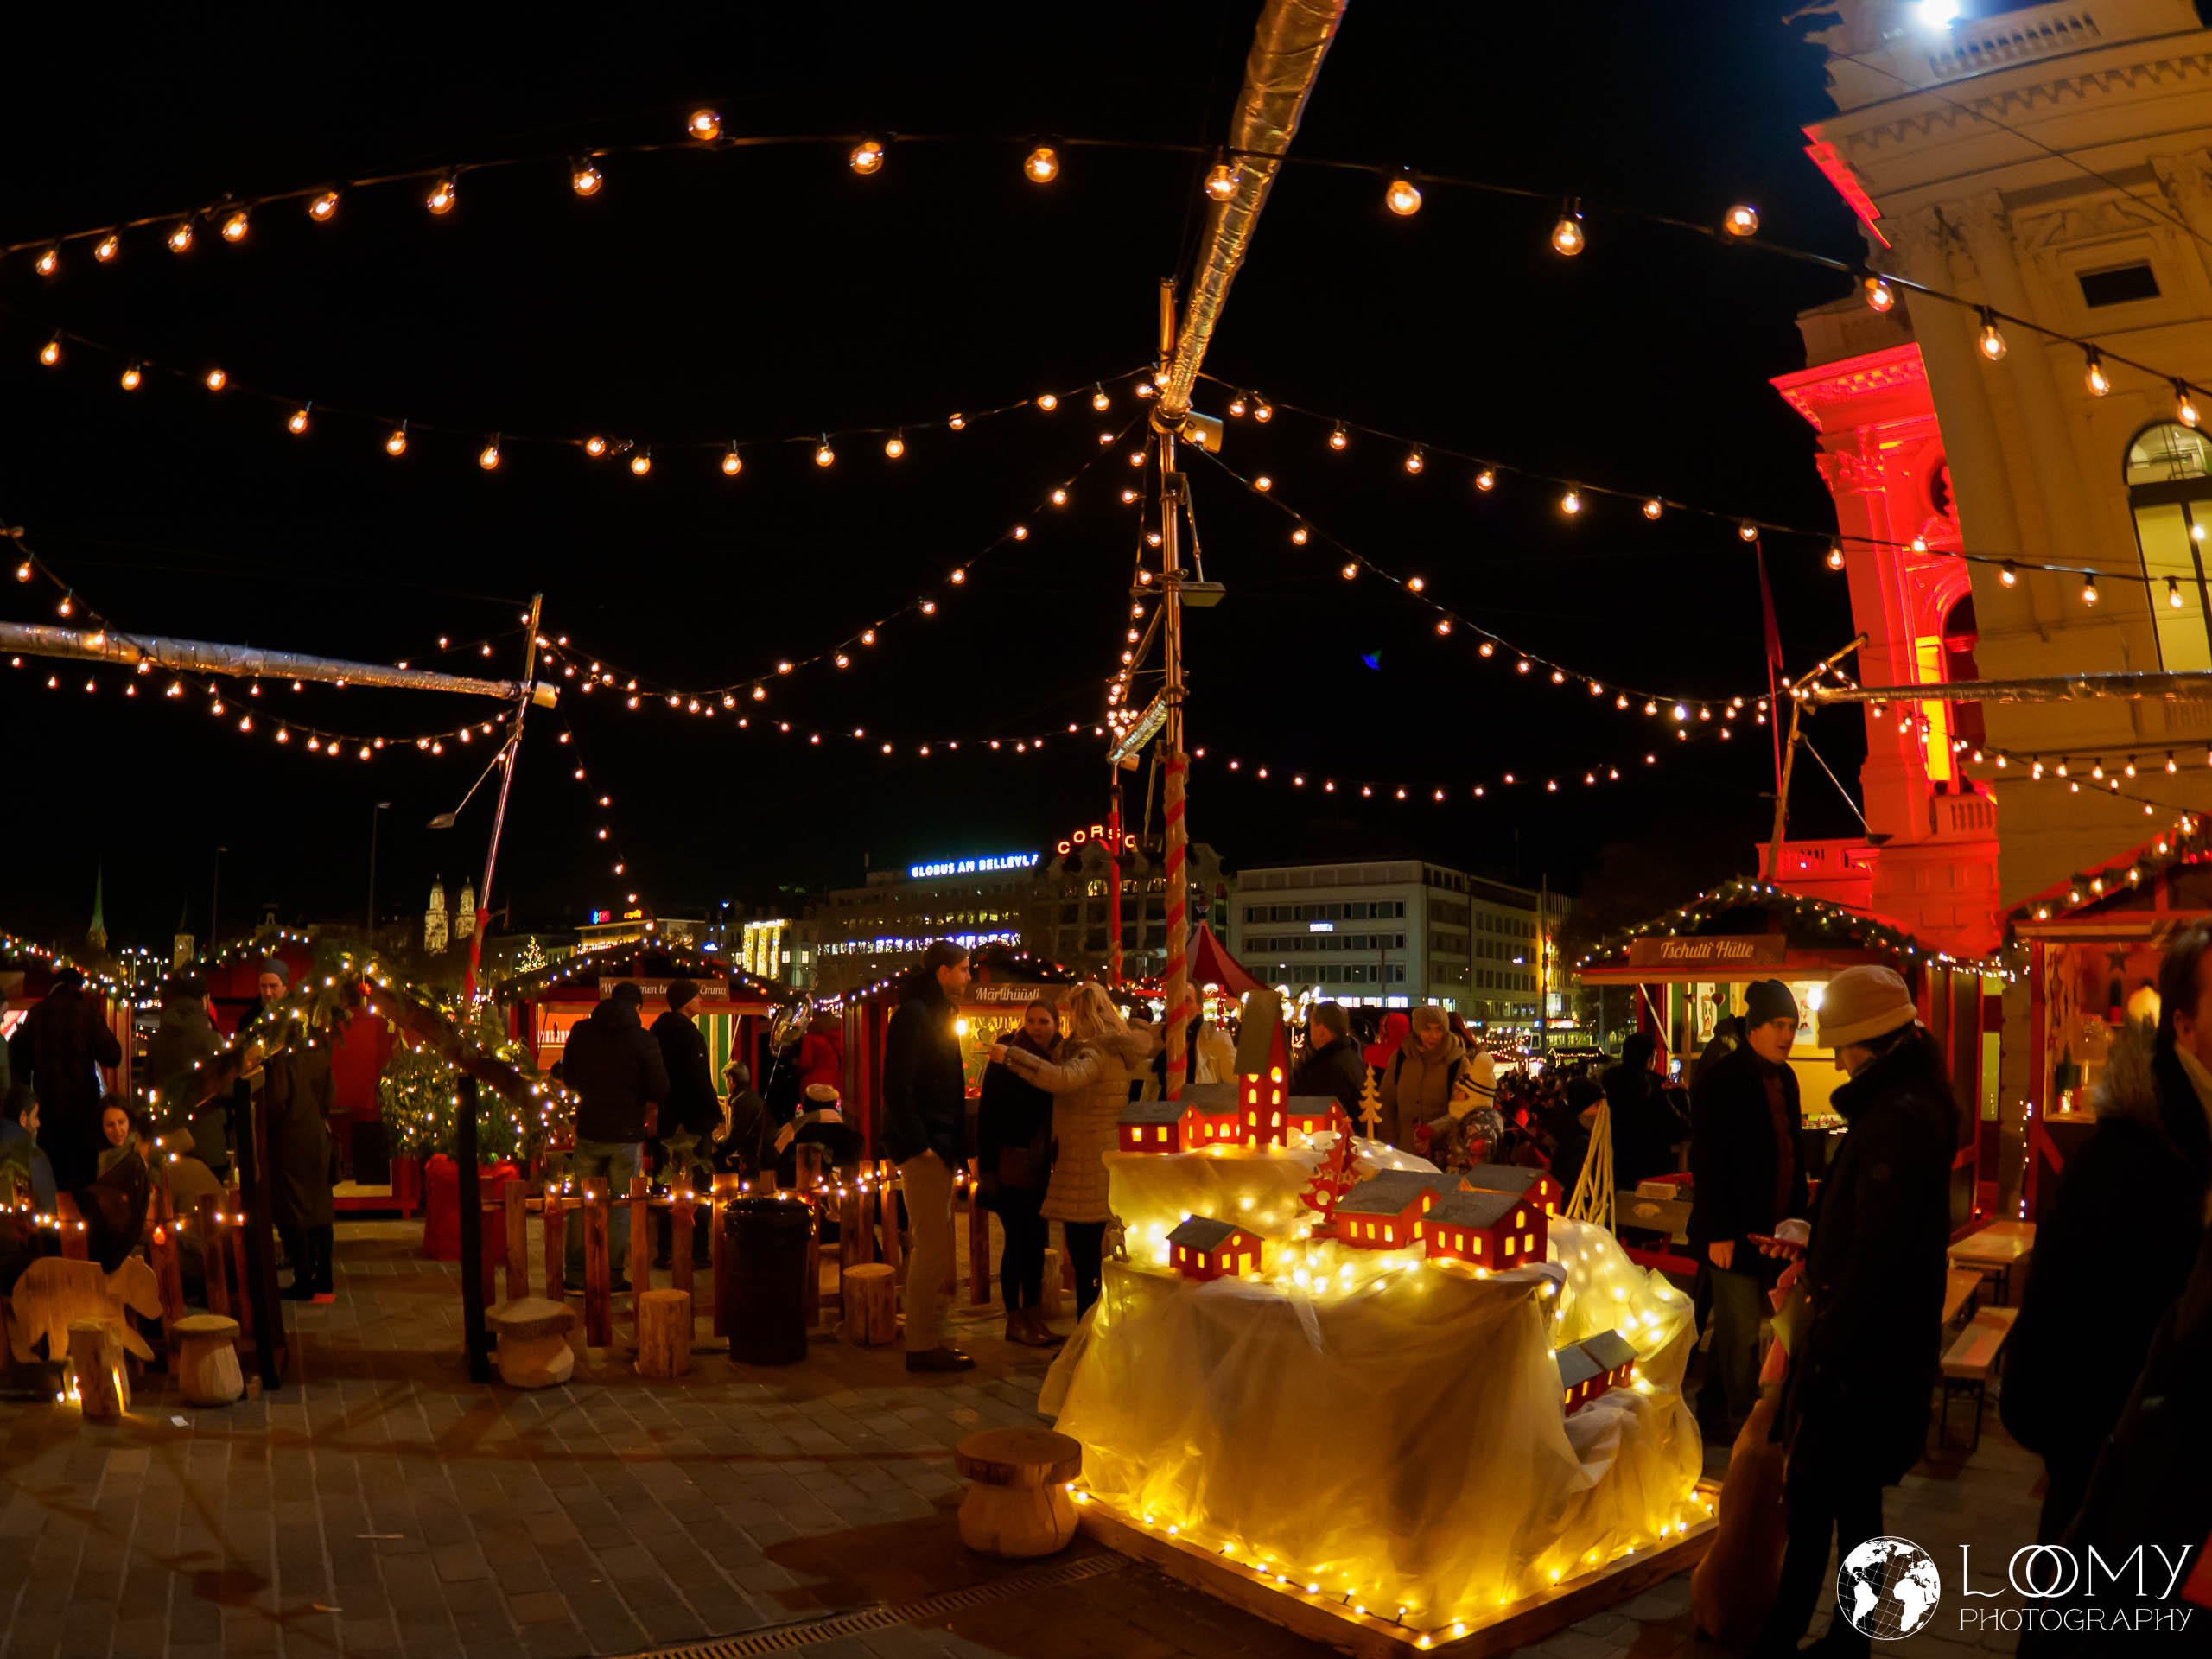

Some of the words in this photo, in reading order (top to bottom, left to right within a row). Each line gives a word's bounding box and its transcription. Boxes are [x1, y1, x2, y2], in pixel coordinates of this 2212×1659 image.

[912, 863, 955, 878] GLOBUS
[957, 860, 976, 873] AM
[1715, 940, 1755, 958] Hütte
[699, 983, 727, 995] Emma
